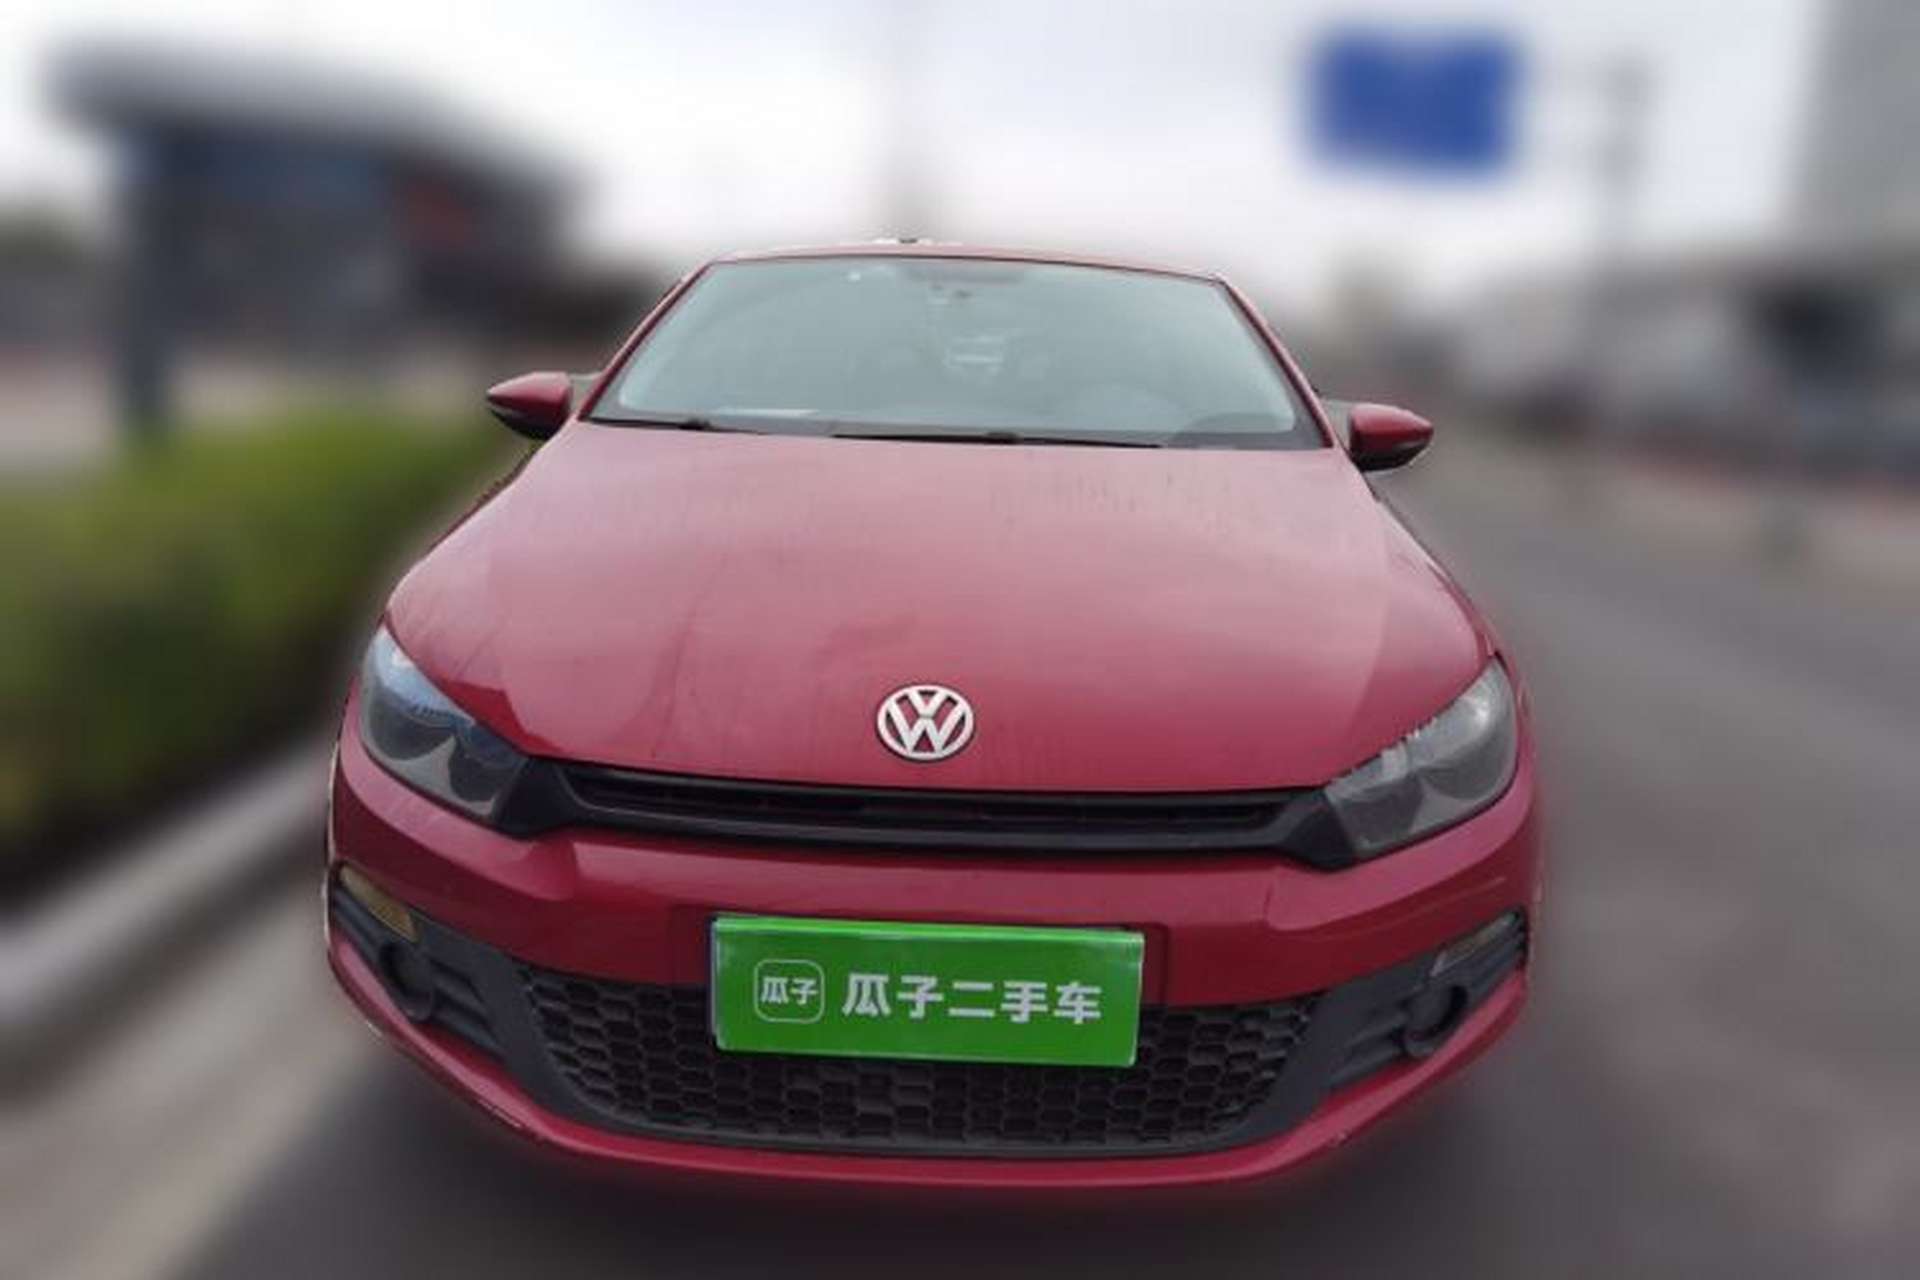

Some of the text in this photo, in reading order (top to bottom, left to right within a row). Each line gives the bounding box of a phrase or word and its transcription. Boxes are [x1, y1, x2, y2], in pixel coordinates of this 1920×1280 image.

[760, 976, 819, 1005] 瓜子
[842, 972, 1102, 1025] 瓜子二手车
